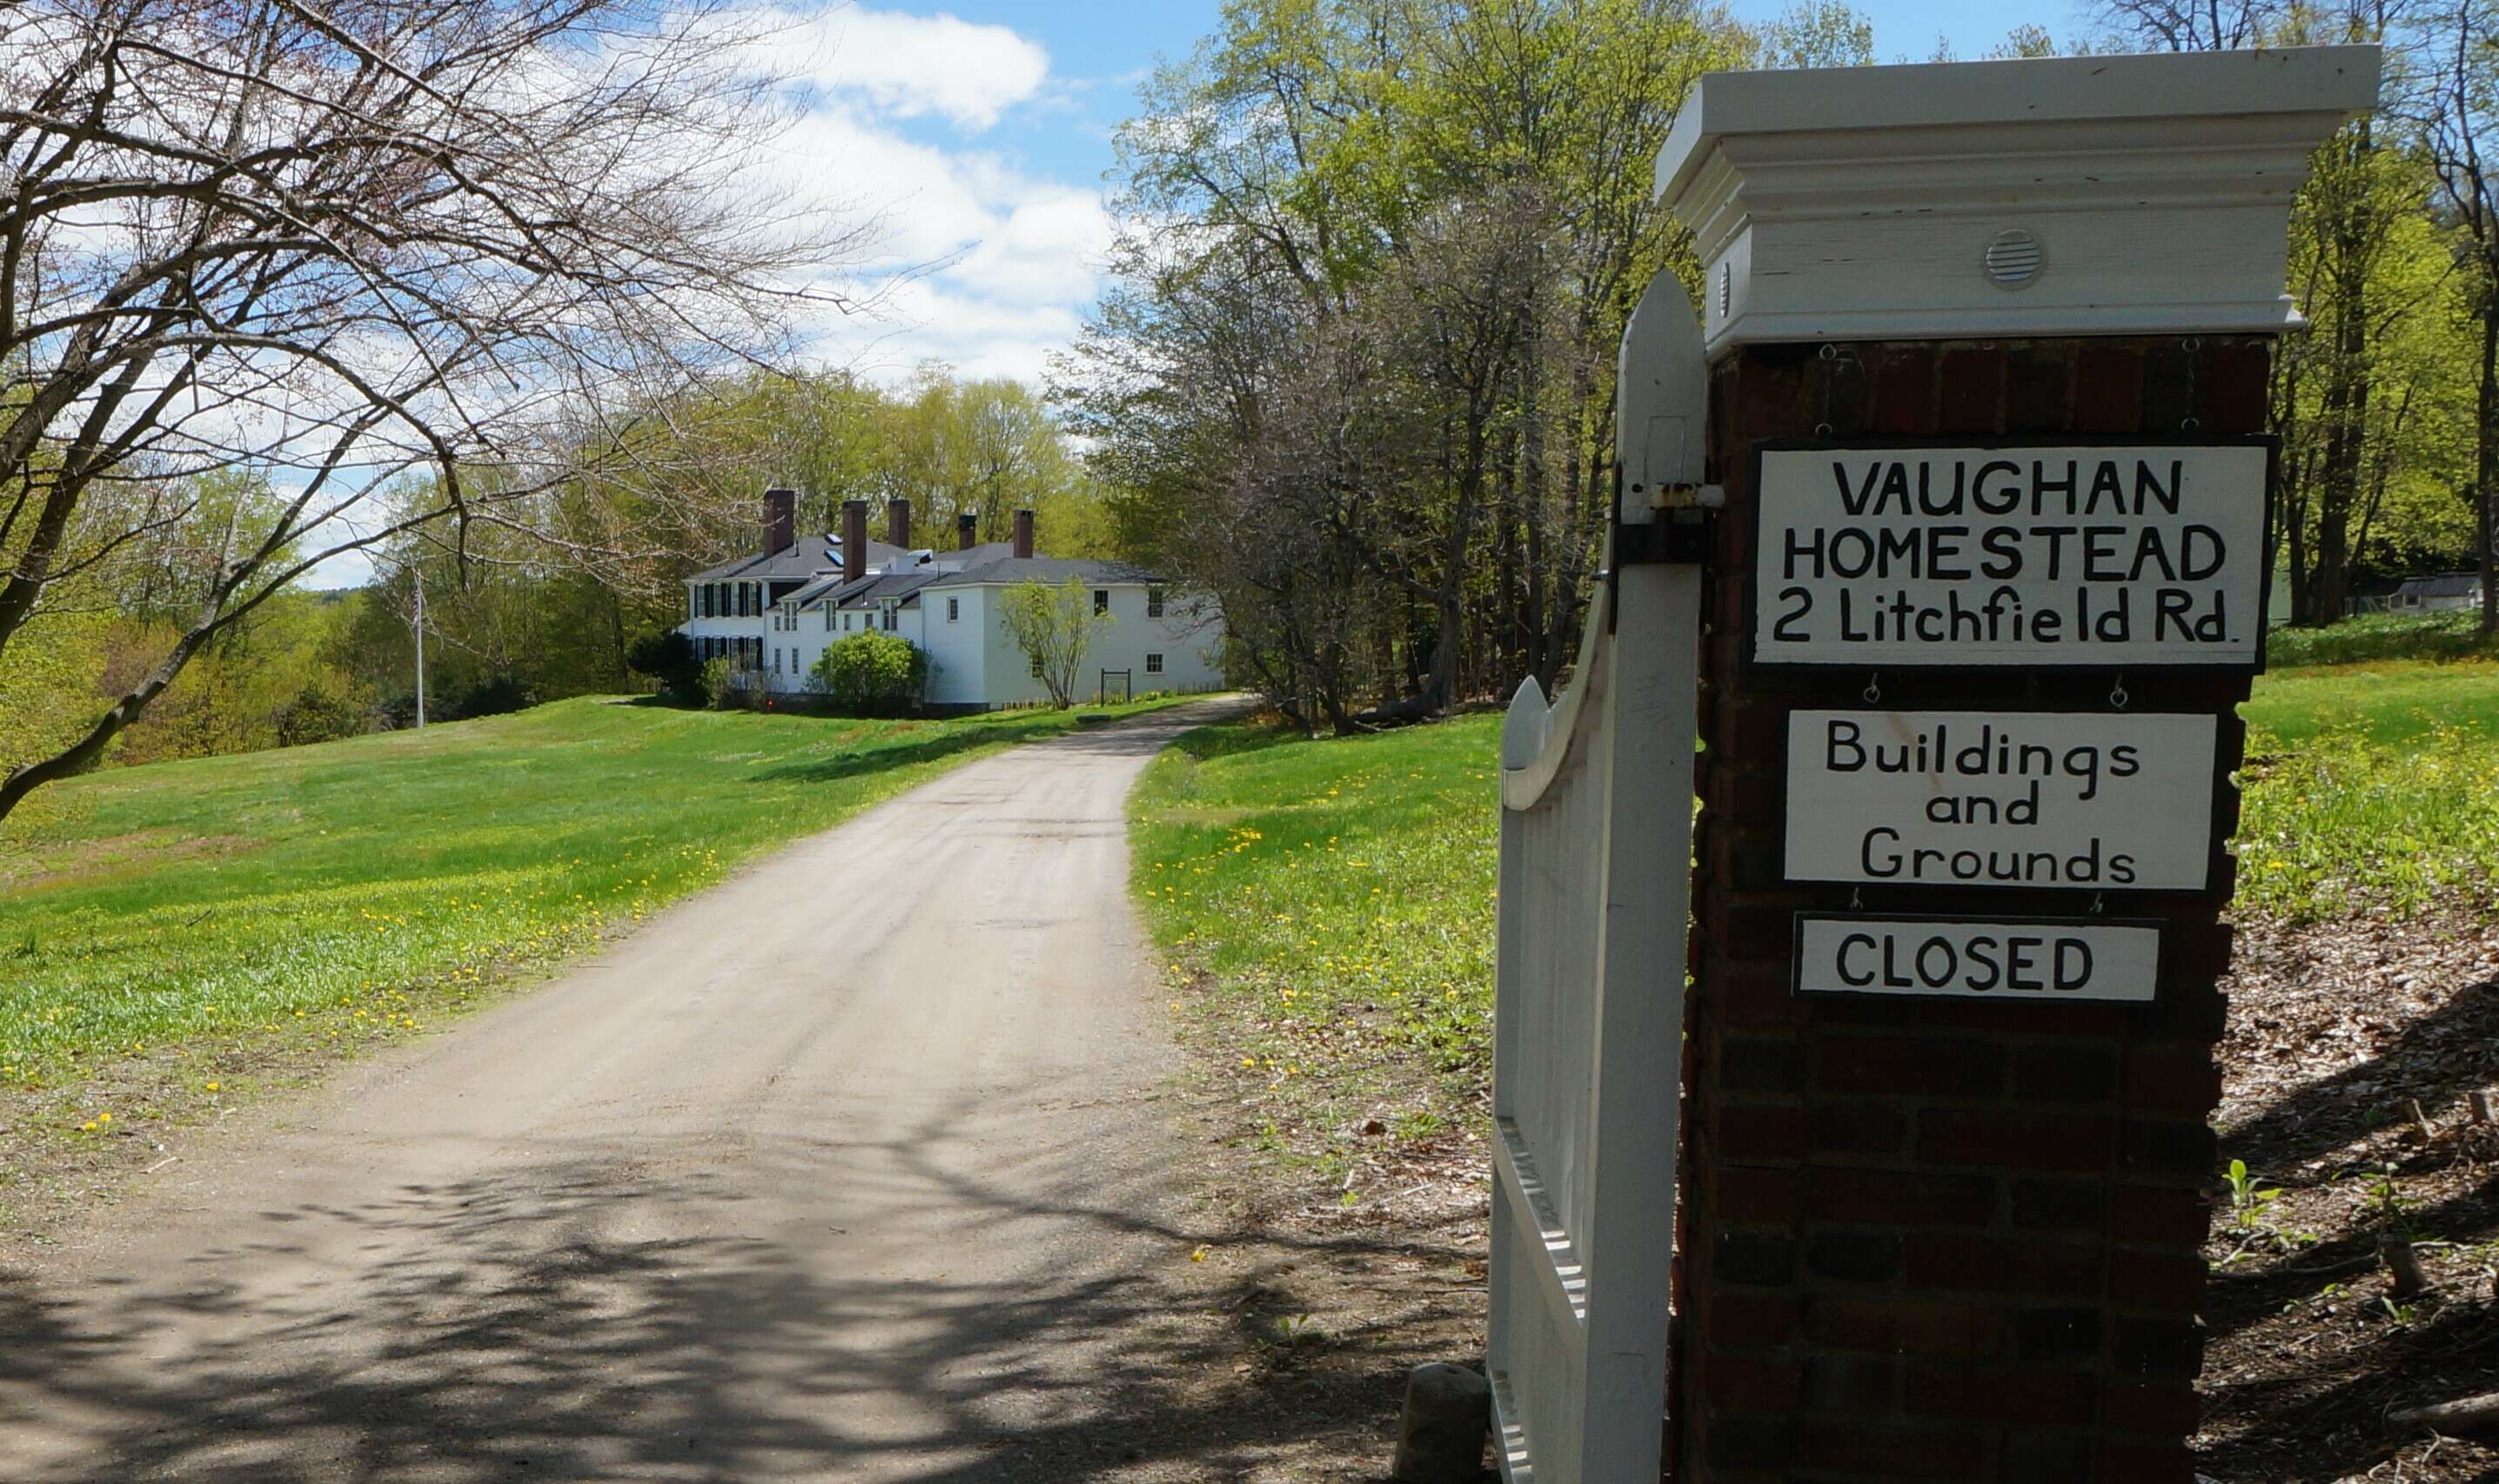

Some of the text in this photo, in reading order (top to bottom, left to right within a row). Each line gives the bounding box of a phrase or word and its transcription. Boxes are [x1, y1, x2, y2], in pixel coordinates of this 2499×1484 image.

[1832, 460, 2182, 516] VAUGHAN
[1784, 525, 2226, 582] HOMESTEAD
[1772, 585, 2241, 643] 2 Litchfield Rd.
[1826, 719, 2141, 801] Buildings
[1925, 779, 2040, 826] and
[1860, 826, 2137, 885] Grounds
[1835, 933, 2094, 993] CLOSED
